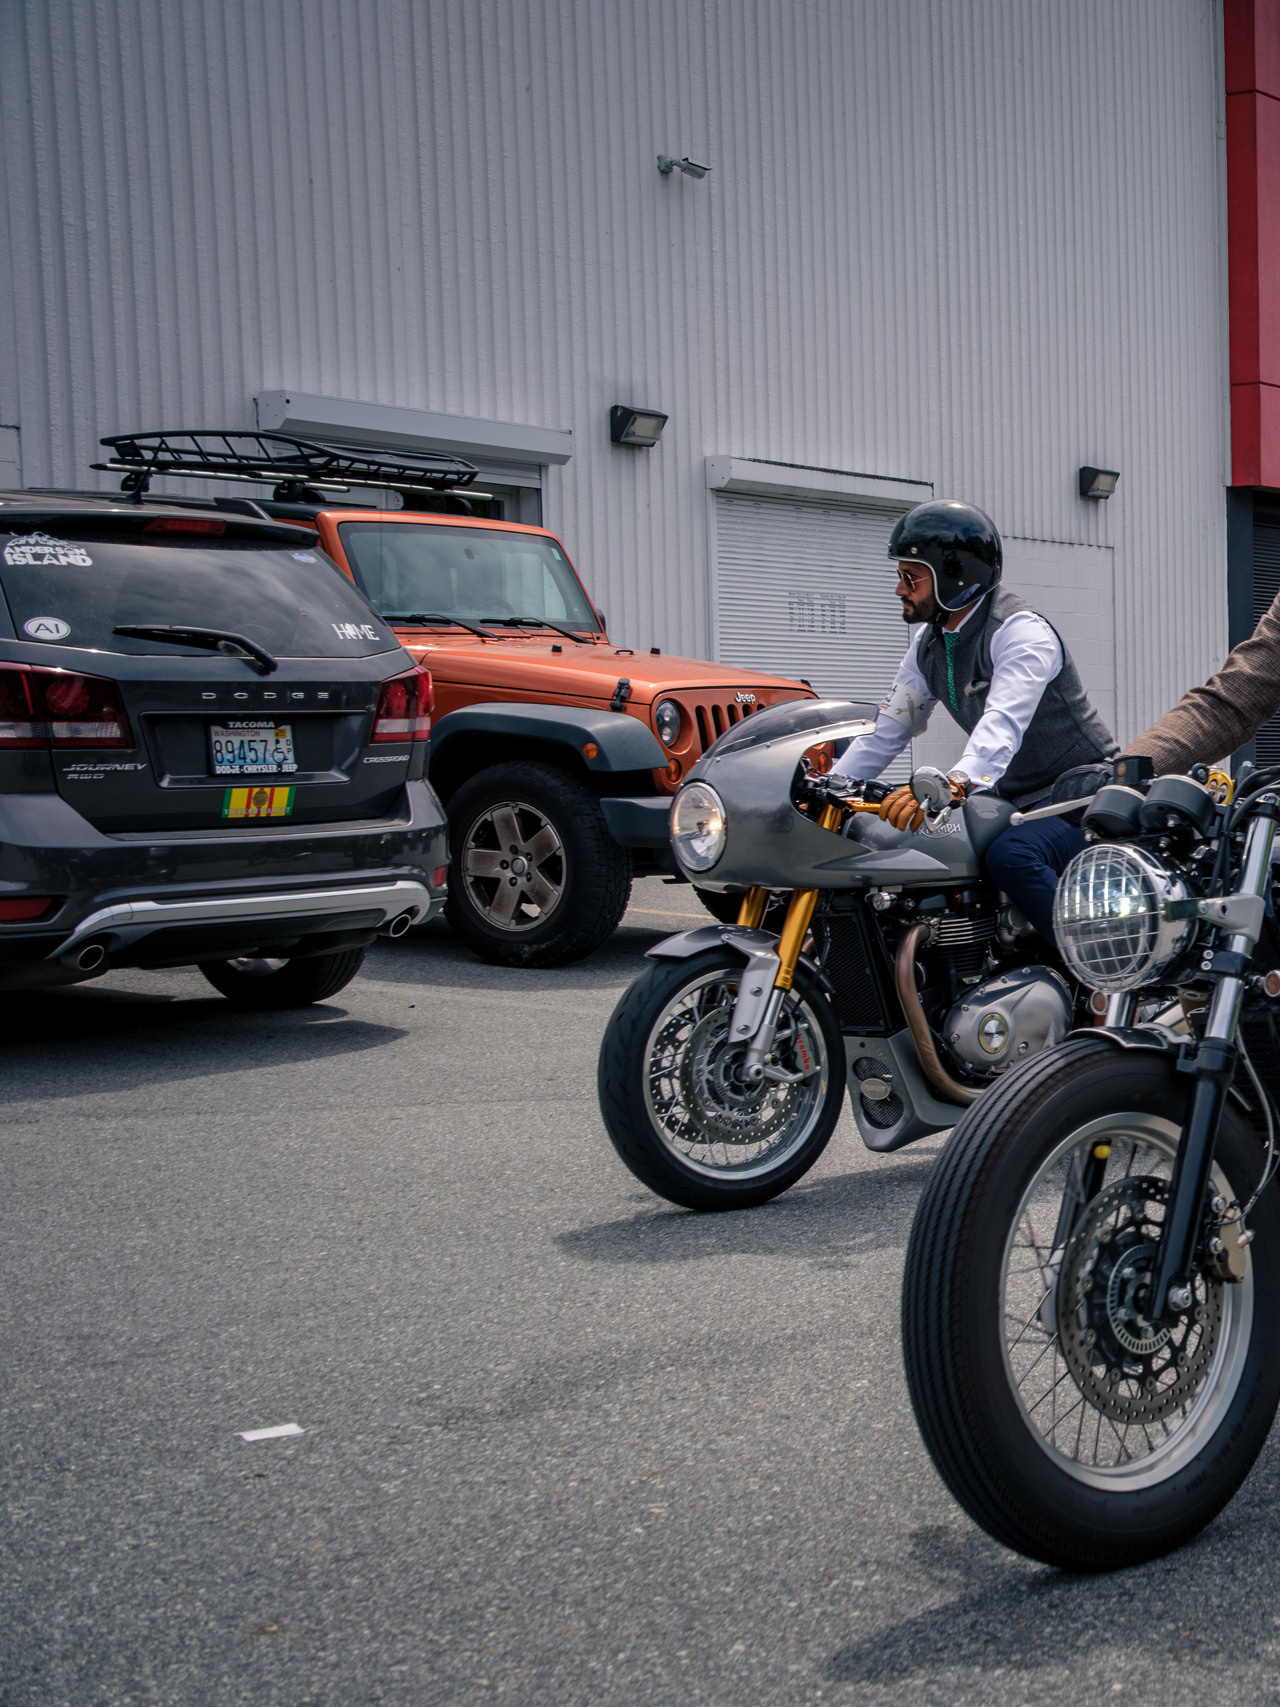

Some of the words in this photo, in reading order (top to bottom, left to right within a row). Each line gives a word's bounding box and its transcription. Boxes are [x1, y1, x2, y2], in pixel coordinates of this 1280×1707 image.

[4, 546, 87, 555] ANDERSON
[4, 553, 93, 567] ISLAND
[34, 623, 60, 634] AI
[331, 623, 381, 641] HME
[735, 691, 756, 705] Jeep
[213, 739, 268, 764] 89457
[363, 754, 410, 764] CROSSROAD
[63, 763, 147, 771] JOURNEY
[796, 1032, 810, 1070] brembo
